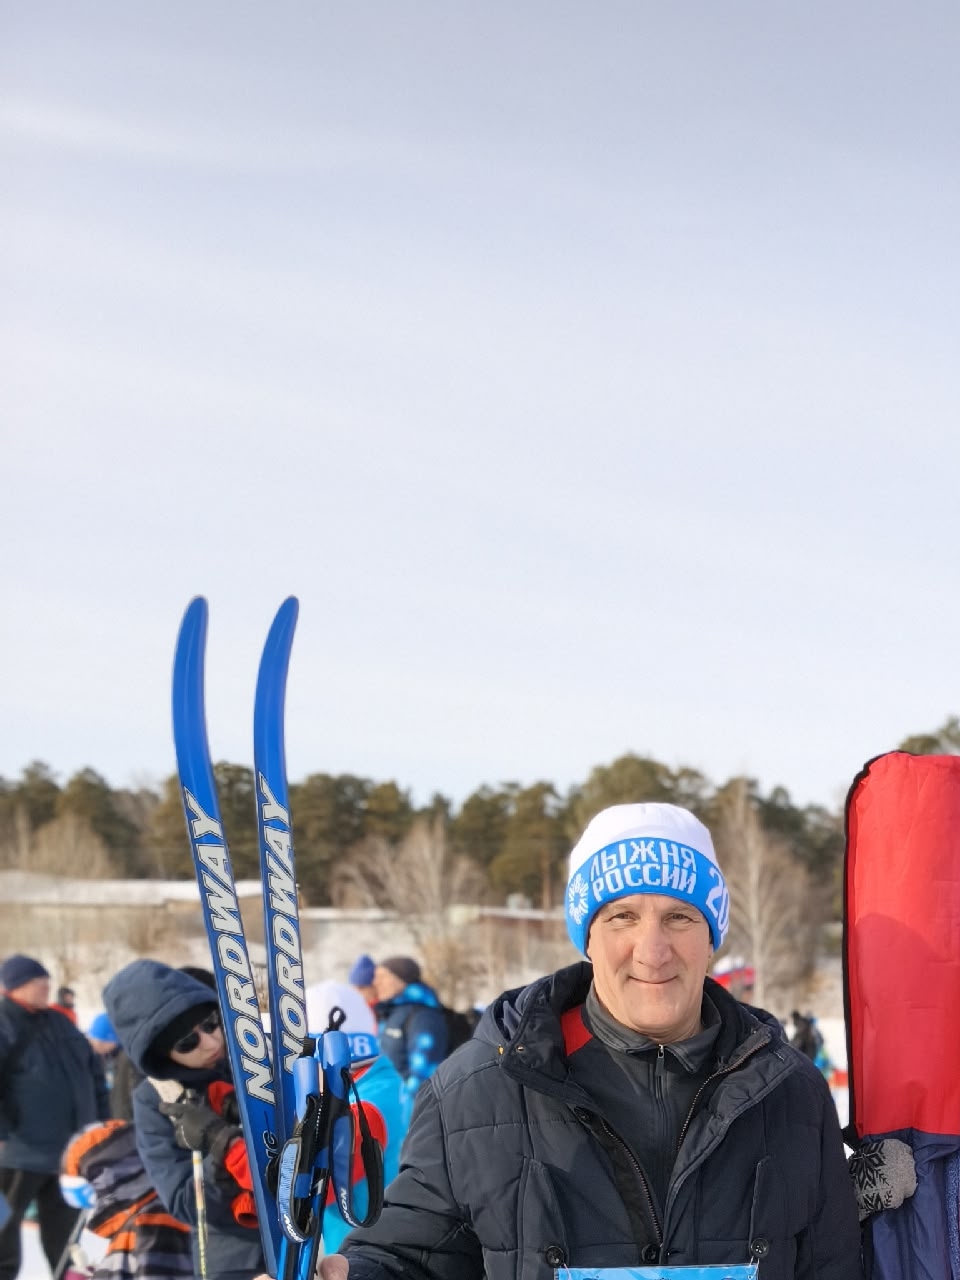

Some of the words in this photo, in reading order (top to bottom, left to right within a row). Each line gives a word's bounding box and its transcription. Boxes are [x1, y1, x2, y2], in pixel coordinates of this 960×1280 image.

[184, 786, 276, 1105] NORDWAY
[258, 771, 308, 1074] NORDWAY
[590, 840, 697, 882] ЛЫЖНЯ
[592, 862, 697, 902] РОССИИ
